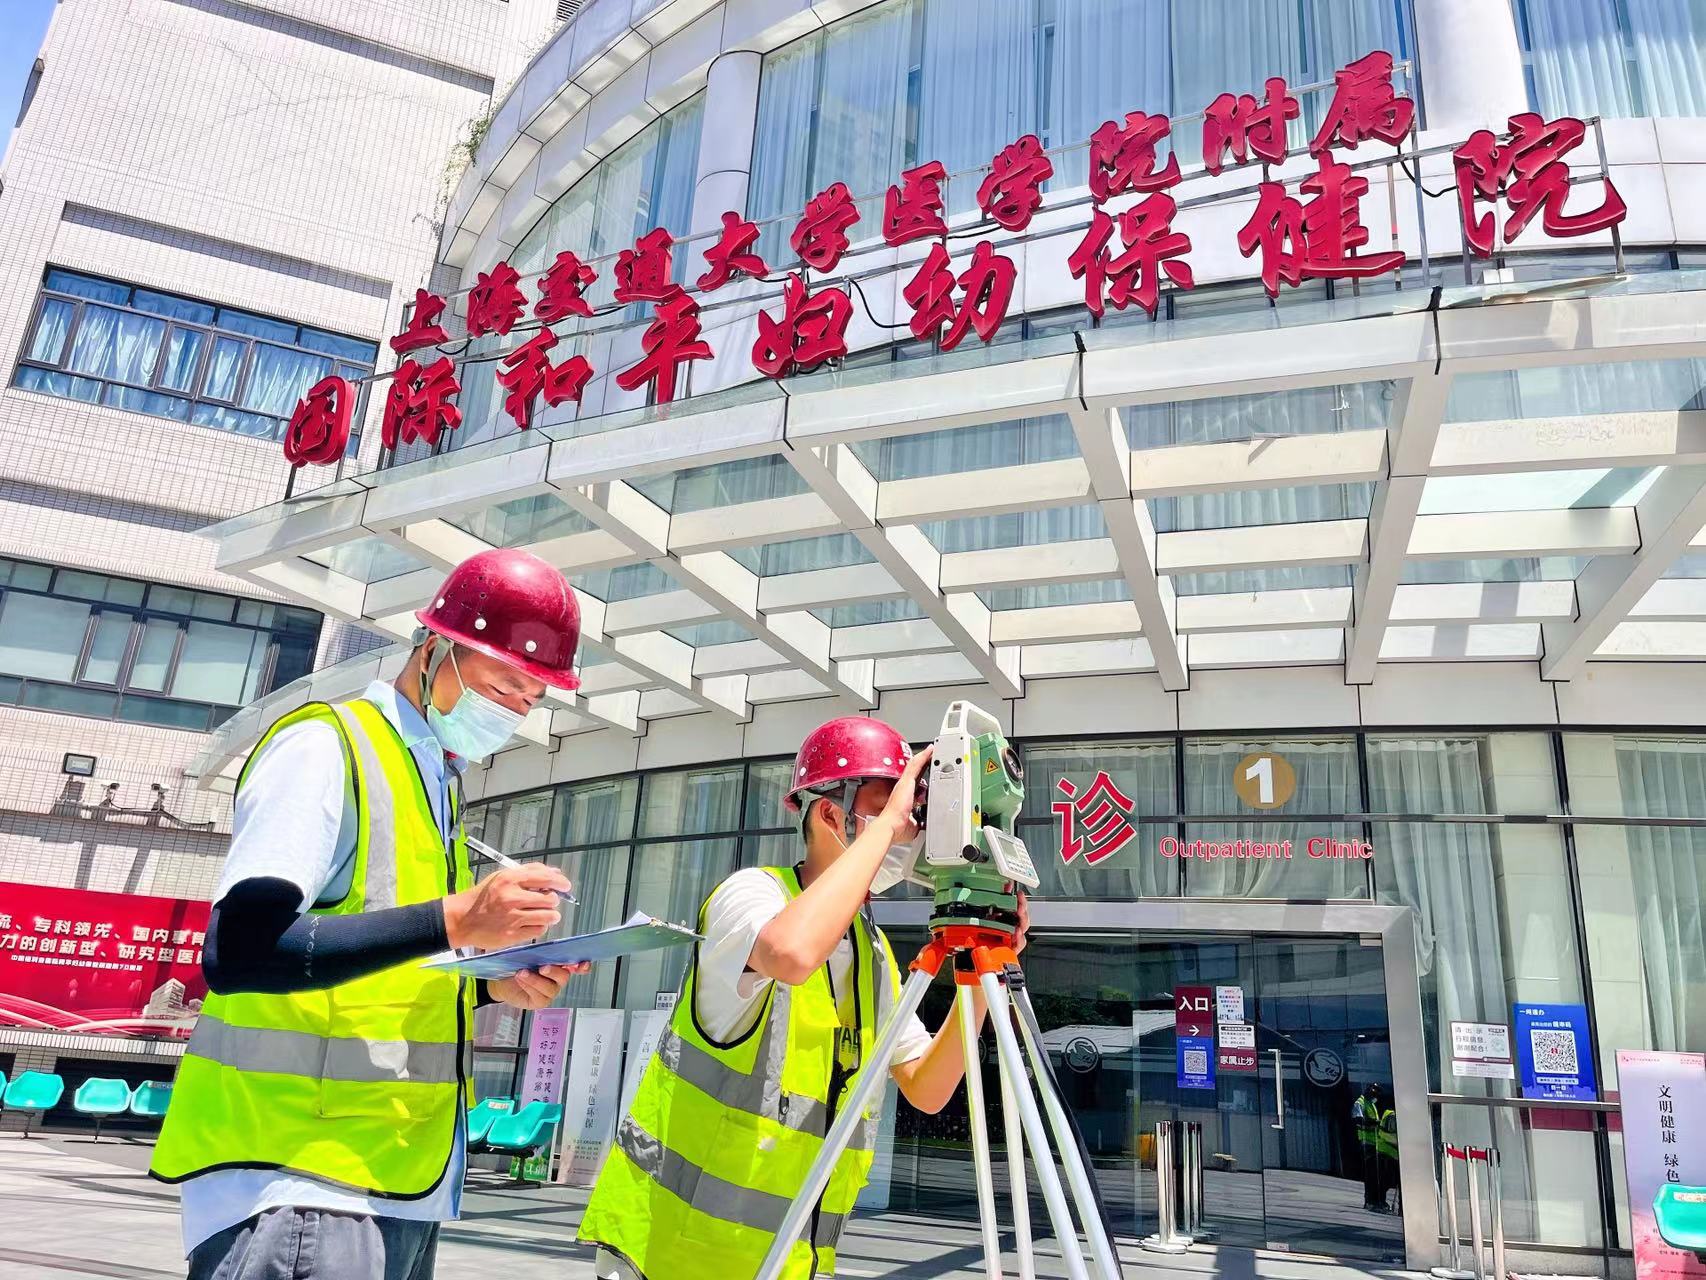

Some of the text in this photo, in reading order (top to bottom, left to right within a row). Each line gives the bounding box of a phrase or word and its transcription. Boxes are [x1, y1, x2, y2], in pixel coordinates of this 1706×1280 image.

[390, 51, 1414, 354] 上海交通大学医学院附属
[284, 112, 1627, 468] 国际和平妇幼保健院
[1245, 757, 1274, 804] 1
[1051, 770, 1137, 866] 诊
[1159, 836, 1374, 862] Outpatient Clinic
[1178, 996, 1209, 1011] 入口
[1219, 1055, 1255, 1066] 家属止步
[1657, 1084, 1680, 1183] 文明健康 绿色
